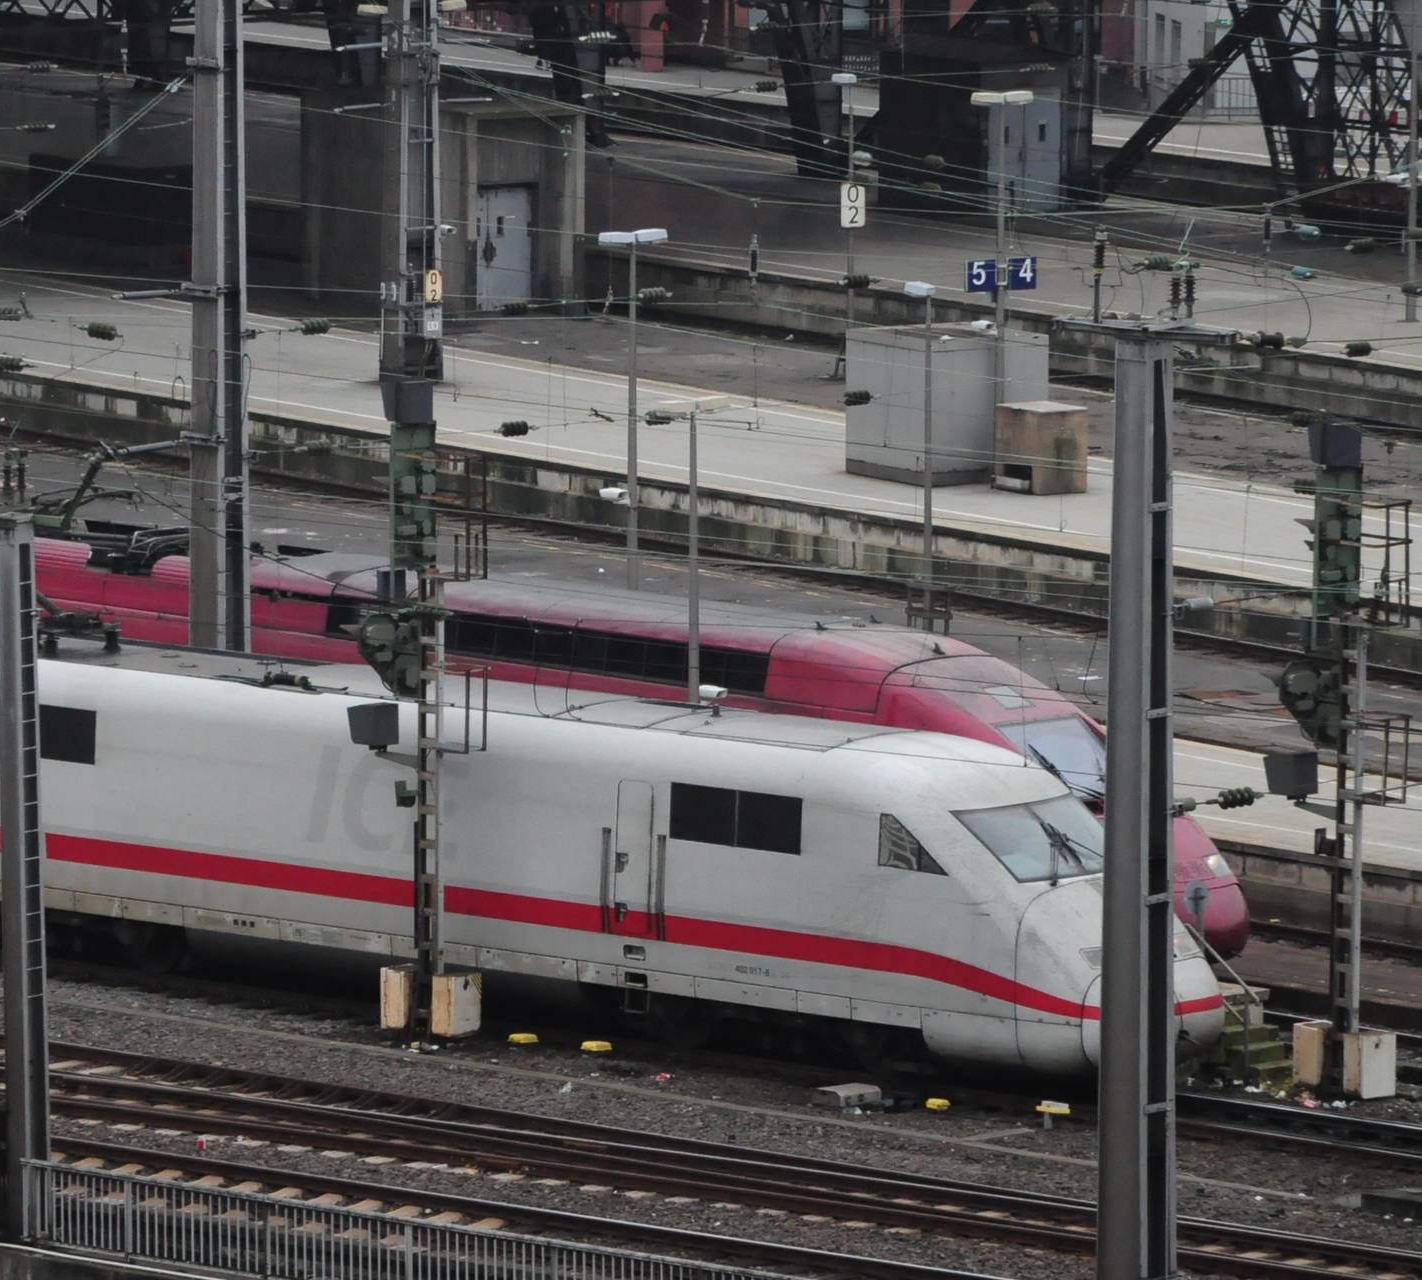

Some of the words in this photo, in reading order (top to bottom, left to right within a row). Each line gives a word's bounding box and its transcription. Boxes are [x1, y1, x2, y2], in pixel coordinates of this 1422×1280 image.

[847, 184, 859, 203] 0
[849, 206, 859, 224] 2
[430, 272, 437, 285] 0
[972, 261, 986, 285] 5
[1019, 258, 1033, 282] 4
[430, 289, 437, 301] 2
